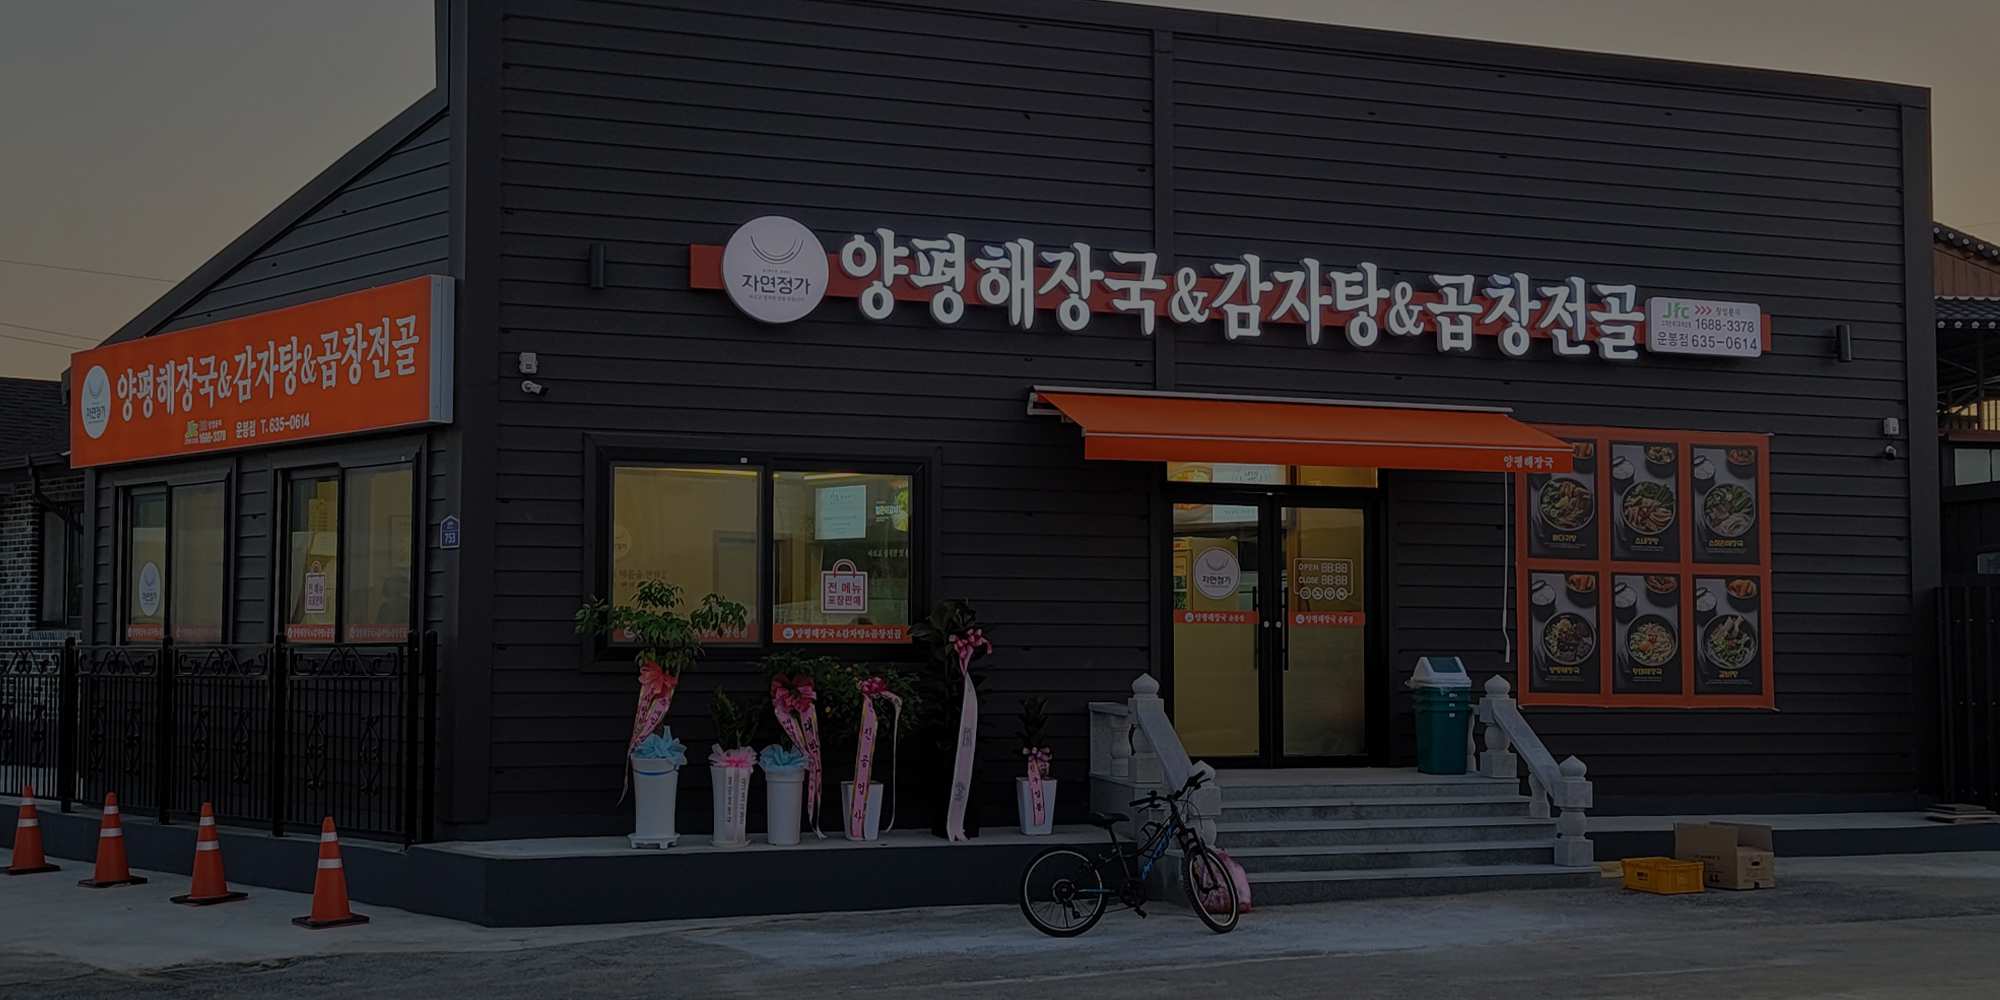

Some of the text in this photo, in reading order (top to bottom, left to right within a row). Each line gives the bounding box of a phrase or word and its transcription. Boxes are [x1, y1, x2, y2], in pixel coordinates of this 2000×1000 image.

[741, 274, 811, 295] 자연정가
[841, 226, 1645, 360] 양평해장국&감자탕&곱창전골
[1662, 302, 1690, 319] Jfc
[1695, 318, 1755, 333] 1688-3378
[1657, 331, 1758, 351] 운봉점 635-0614
[117, 314, 420, 422] 양평해장국&감자탕&곱창전골
[235, 419, 256, 439] 운봉점
[1503, 454, 1555, 470] 양평해장국
[444, 532, 456, 544] 753
[1298, 563, 1319, 571] OPEN
[1201, 575, 1231, 585] 자연정가
[1298, 576, 1319, 584] CLOSE
[828, 582, 861, 594] 전 메뉴
[828, 595, 861, 606] 포장판매
[1194, 613, 1227, 623] 양평해장국
[1305, 613, 1337, 624] 양평해장국
